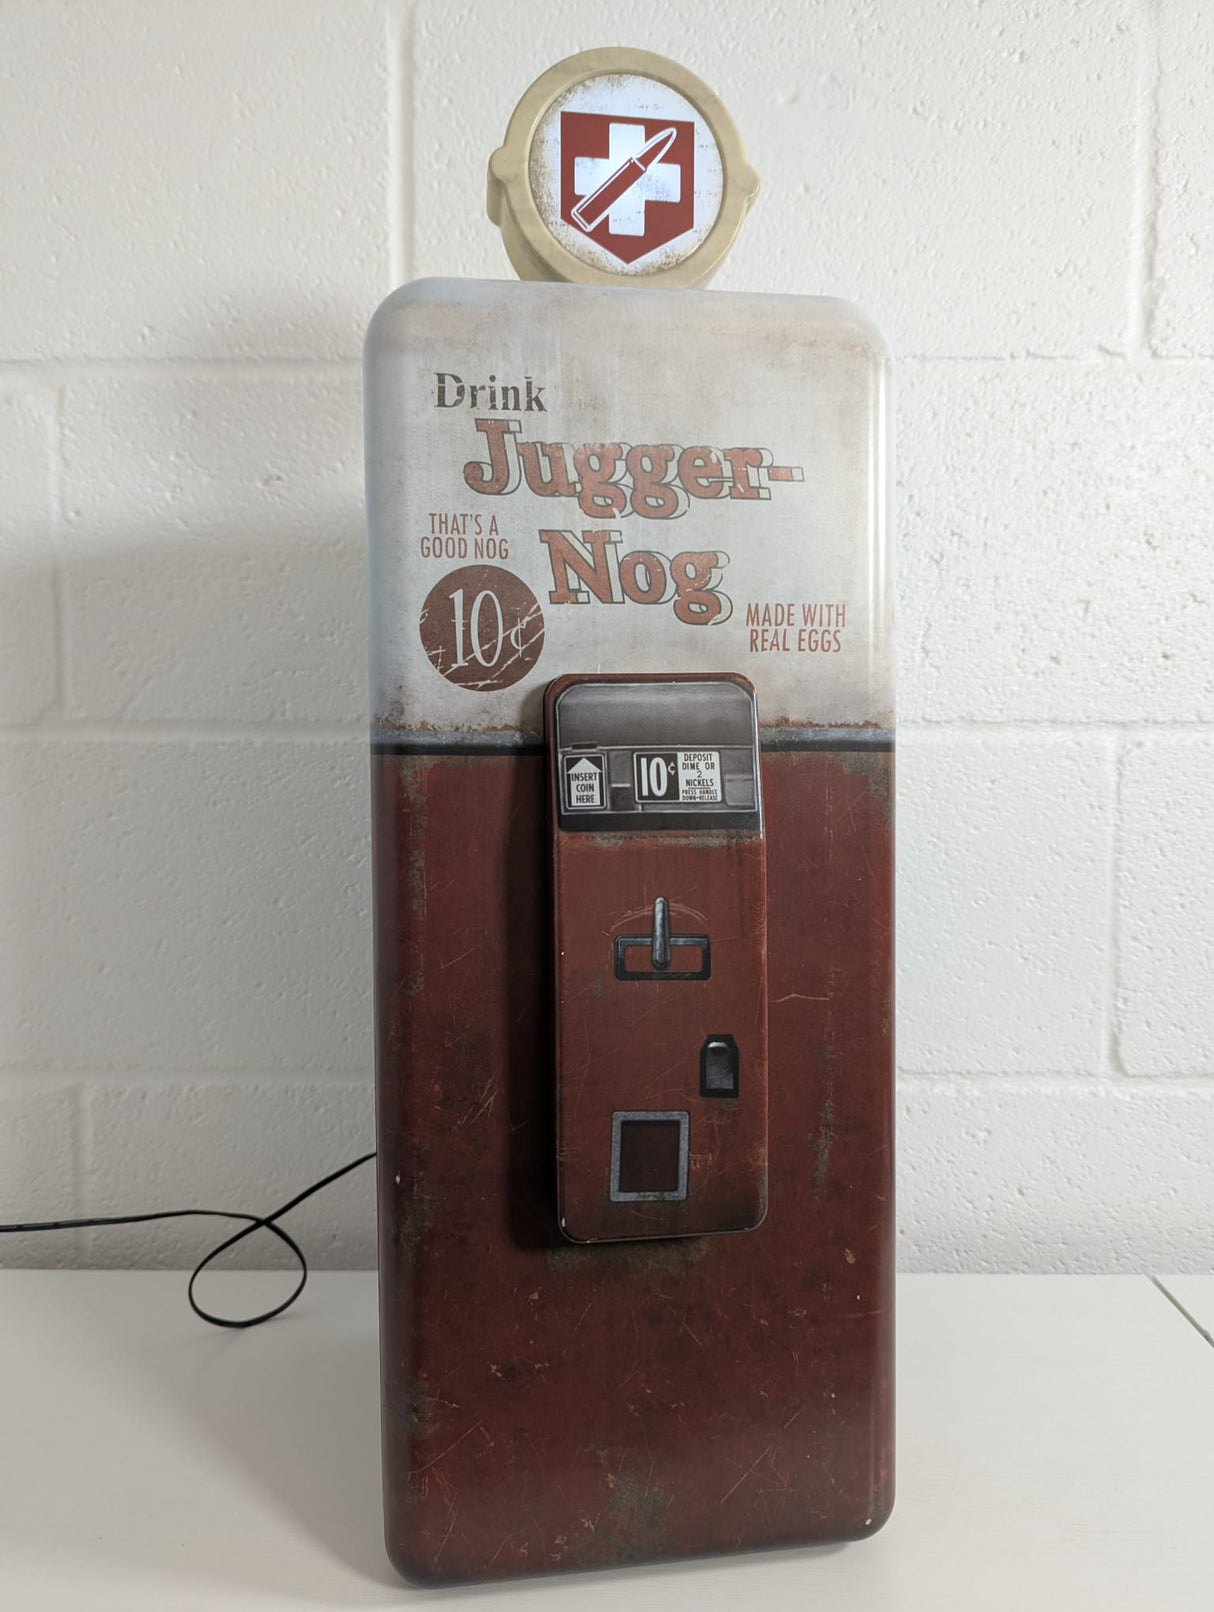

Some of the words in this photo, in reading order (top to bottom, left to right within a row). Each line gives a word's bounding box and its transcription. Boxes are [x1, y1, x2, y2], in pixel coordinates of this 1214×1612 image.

[433, 372, 547, 412] Drink
[463, 418, 805, 519] Jugger-
[428, 513, 483, 536] THAT'S
[489, 515, 499, 536] A
[420, 536, 468, 559] GOOD
[474, 538, 509, 560] NOG
[539, 529, 733, 625] Nog
[745, 602, 795, 626] MADE
[802, 603, 846, 627] WITH
[749, 628, 790, 652] REAL
[797, 628, 841, 652] EGGS
[683, 753, 713, 762] DEPOSIT
[682, 762, 700, 770] DIME
[704, 762, 715, 770] OR
[696, 770, 703, 778] 2
[571, 772, 598, 782] INSERT
[685, 778, 714, 787] NICKELS
[575, 783, 595, 793] COIN
[575, 794, 595, 804] HERE
